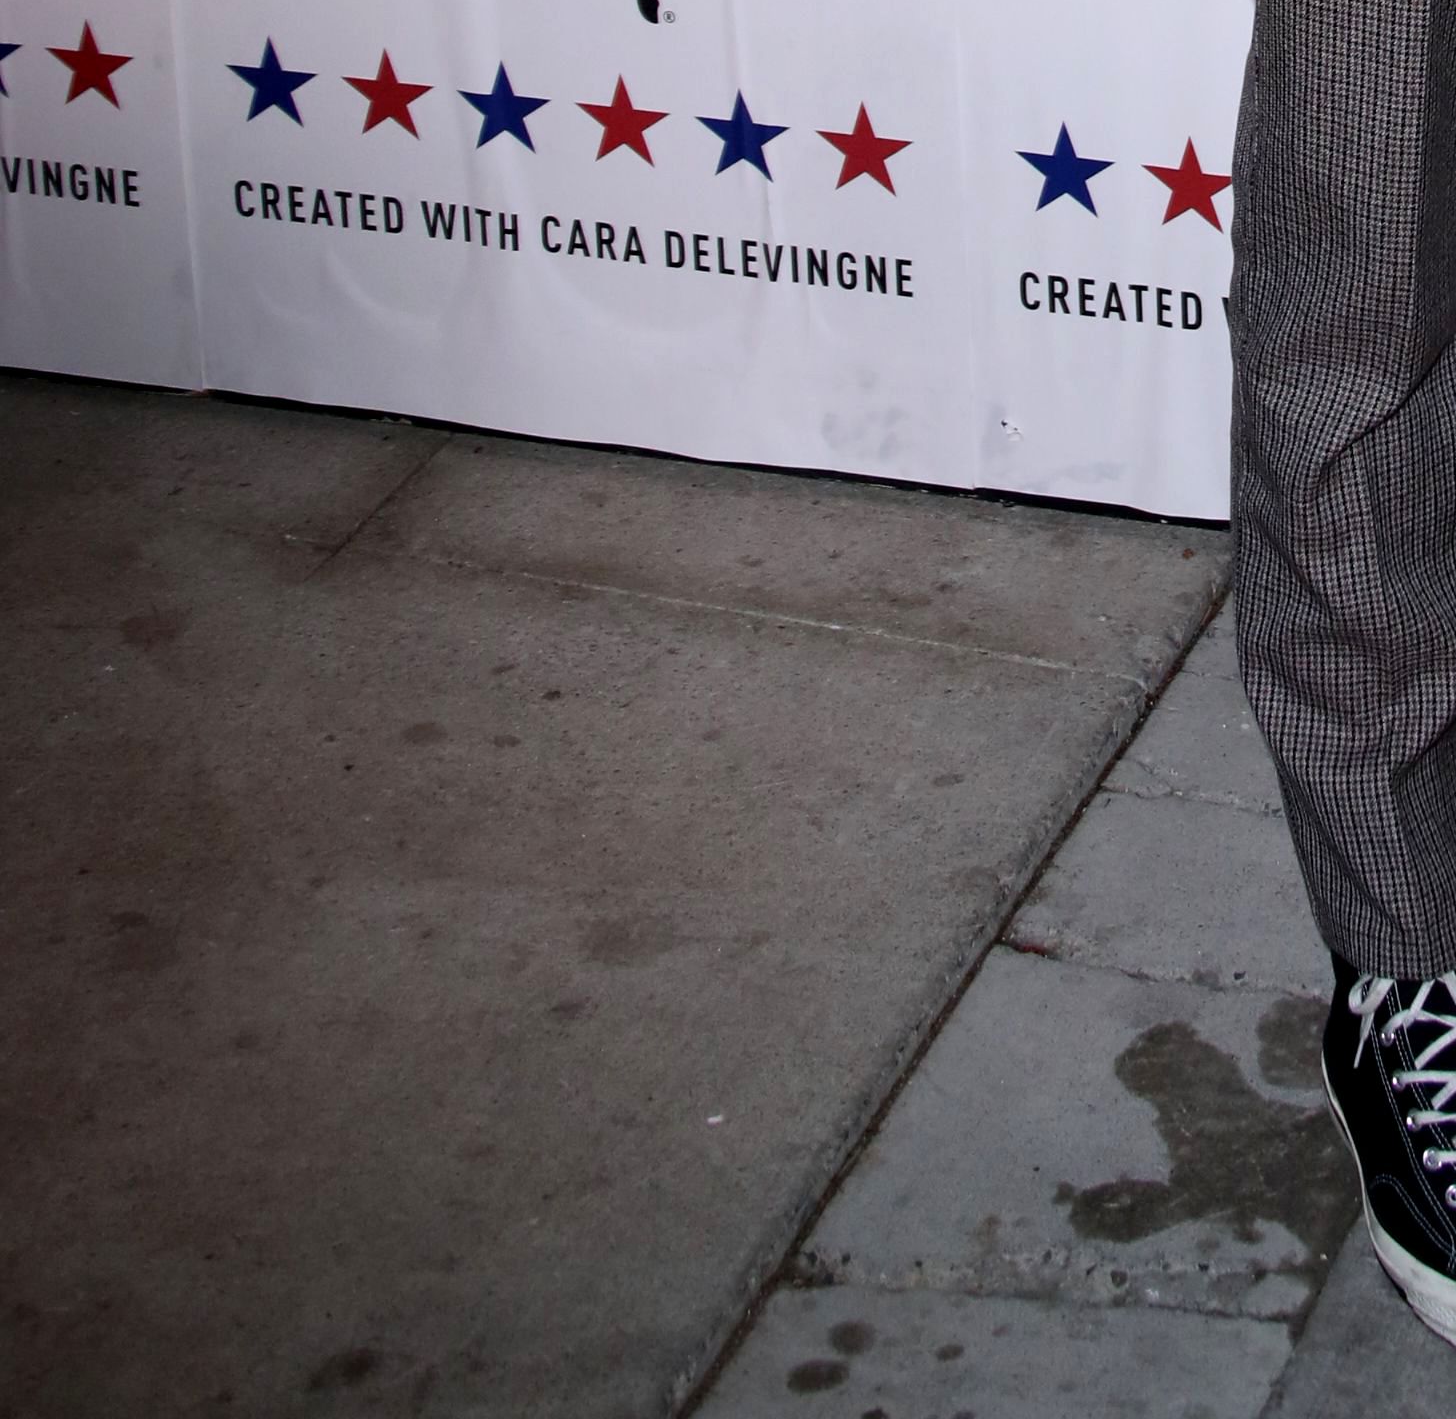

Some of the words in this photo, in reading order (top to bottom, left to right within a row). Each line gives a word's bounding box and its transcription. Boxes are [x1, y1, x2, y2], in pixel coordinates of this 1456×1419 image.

[0, 156, 140, 208] VINGNE
[234, 180, 404, 234] CREATED
[420, 200, 519, 252] WITH
[541, 215, 647, 265] CARA
[664, 230, 914, 298] DELEVINGNE
[1019, 271, 1203, 331] CREATED
